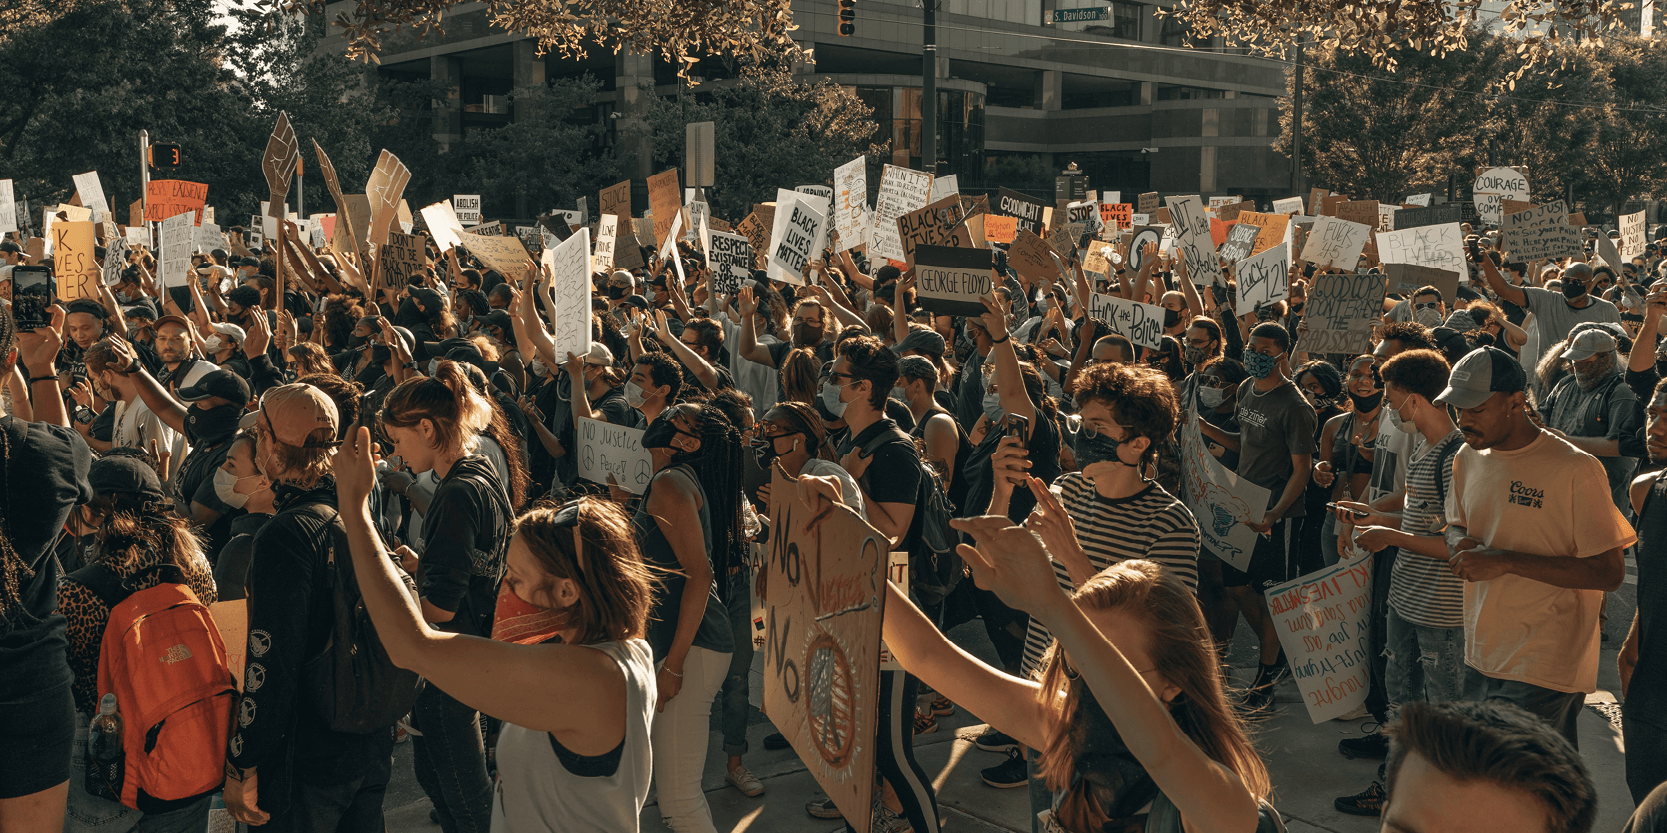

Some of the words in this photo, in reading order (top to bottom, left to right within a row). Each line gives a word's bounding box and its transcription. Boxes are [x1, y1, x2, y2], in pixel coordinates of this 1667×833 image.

[1055, 13, 1061, 21] S.
[1064, 10, 1096, 20] Davidson
[885, 166, 907, 182] WHEN
[908, 173, 929, 189] IT'S
[1475, 175, 1526, 193] COURAGE
[456, 198, 479, 208] ABOLISH
[1100, 204, 1128, 213] BLACK
[790, 206, 818, 238] BLACK
[900, 207, 942, 237] BLACK
[1068, 204, 1094, 223] STOP
[1241, 214, 1270, 227] BLACK
[1512, 210, 1533, 226] NO
[1627, 213, 1639, 224] NO
[602, 225, 615, 238] LOVE
[749, 215, 765, 233] BLACK
[1622, 221, 1645, 237] JUSTICE
[739, 222, 762, 250] MATTER
[786, 228, 811, 256] LIVES
[905, 225, 945, 256] LIVES
[1323, 221, 1354, 248] FUCK
[1388, 227, 1454, 250] BLACK
[1628, 234, 1639, 245] NO
[396, 246, 405, 261] TO
[407, 249, 418, 262] BE
[711, 234, 749, 257] RESPECT
[1321, 241, 1344, 259] 45
[1391, 243, 1447, 264] LIVES
[1620, 241, 1644, 256] PEACE
[381, 258, 402, 274] BLACK
[403, 261, 413, 275] TO
[595, 255, 610, 267] HATE
[719, 262, 733, 276] OR
[921, 268, 959, 295] GEORGE
[961, 272, 991, 296] FLOYD
[1315, 274, 1351, 299] GOOD
[1351, 274, 1387, 299] COPS
[1118, 309, 1131, 322] the
[1128, 303, 1161, 347] Police
[1326, 315, 1351, 330] THE
[1296, 328, 1330, 353] BAD
[600, 426, 638, 452] Justice
[600, 453, 627, 483] Peace!
[1510, 479, 1545, 499] Coors
